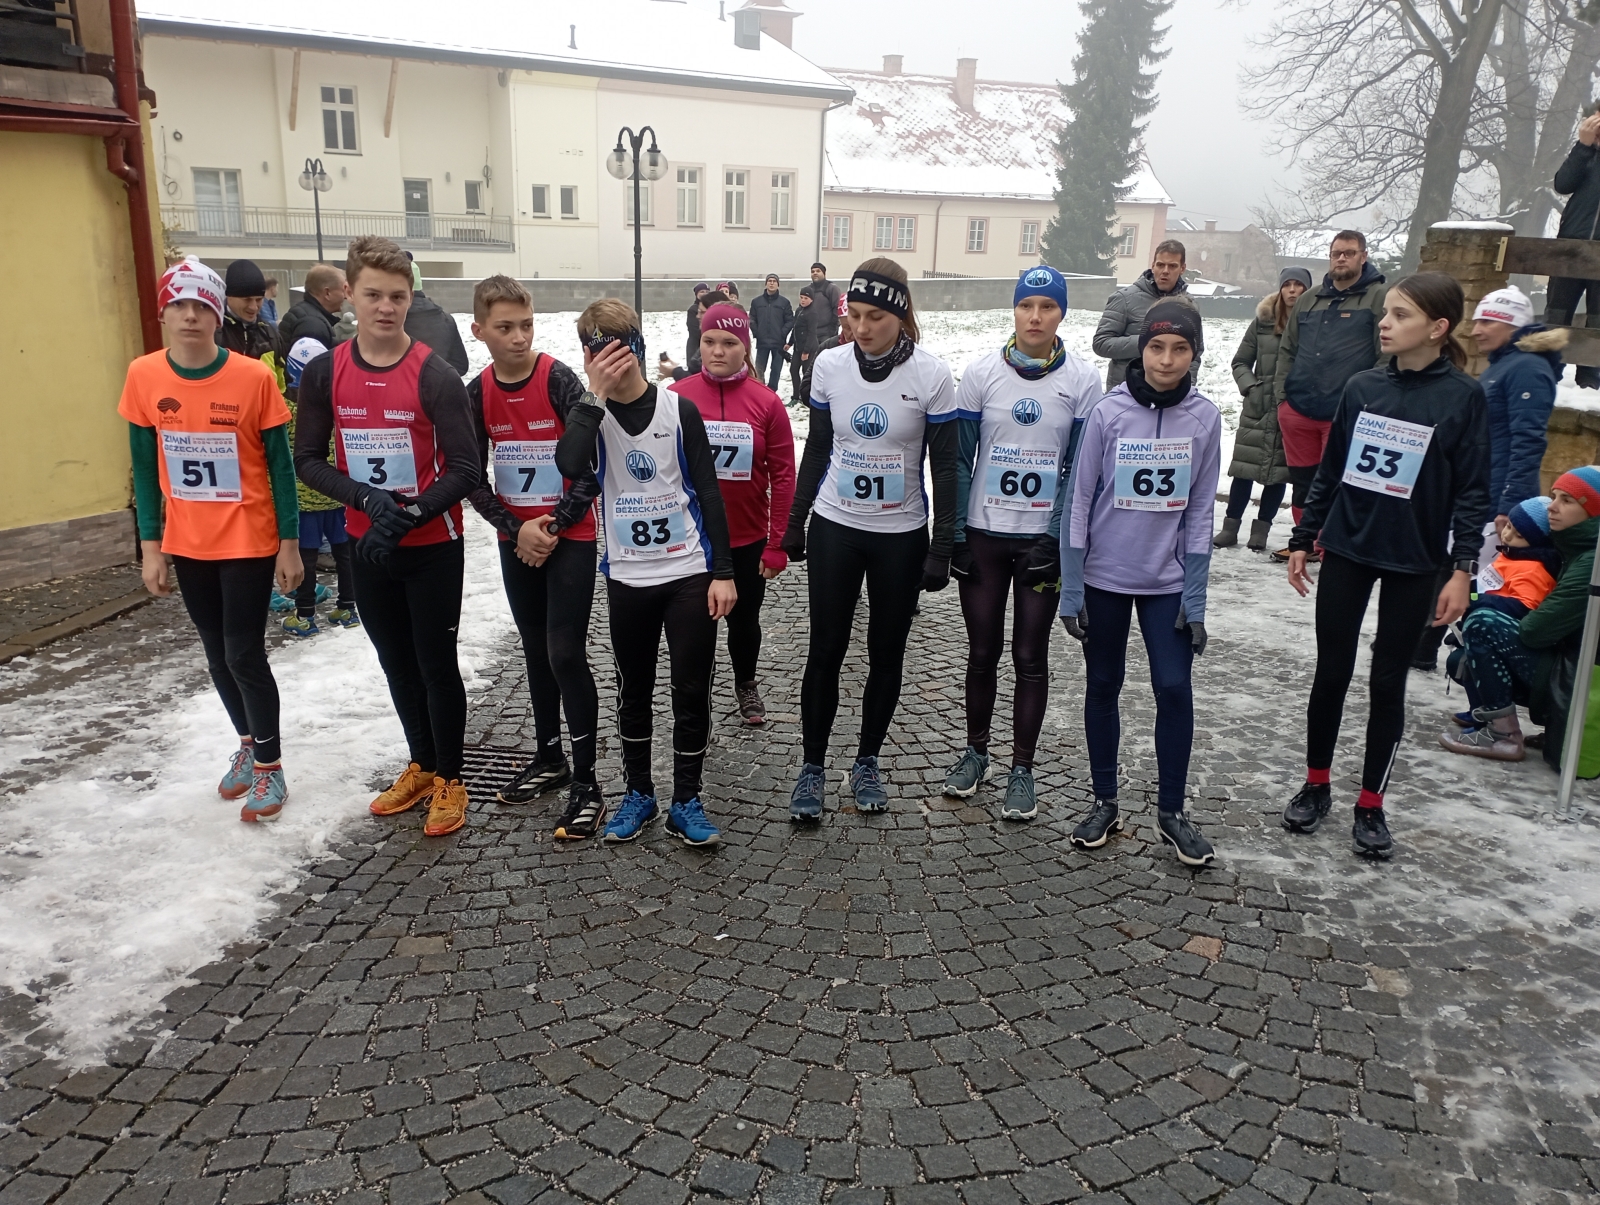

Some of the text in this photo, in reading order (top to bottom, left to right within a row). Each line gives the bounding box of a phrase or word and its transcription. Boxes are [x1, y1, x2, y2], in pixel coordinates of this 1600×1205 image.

[716, 317, 750, 329] INOV
[384, 409, 414, 419] MARATON
[527, 419, 555, 429] MARATON
[1359, 417, 1387, 430] ZIMNÍ
[164, 434, 191, 445] ZIMNÍ
[344, 432, 370, 442] ZIMNÍ
[1355, 426, 1397, 443] BĚŽECKÁ
[1400, 437, 1424, 449] LIGA
[164, 444, 208, 454] BĚŽECKÁ
[345, 442, 409, 450] BĚŽECKÁ LIGA
[496, 444, 521, 453] ZIMNÍ
[992, 445, 1020, 456] ZIMNÍ
[1119, 442, 1152, 452] ZIMNÍ
[710, 445, 739, 468] 77
[842, 449, 865, 461] ZIMNÍ
[991, 454, 1033, 465] BĚŽECKÁ
[841, 458, 879, 469] BĚŽECKÁ
[1356, 444, 1403, 479] 53
[182, 460, 218, 487] 51
[367, 457, 388, 485] 3
[518, 468, 536, 493] 7
[1000, 470, 1042, 498] 60
[1133, 468, 1176, 497] 63
[854, 475, 884, 500] 91
[615, 496, 643, 505] ZIMNÍ
[615, 505, 658, 513] BĚŽECKÁ
[660, 500, 679, 510] LIGA
[631, 517, 671, 547] 83
[1482, 576, 1496, 589] LIGA
